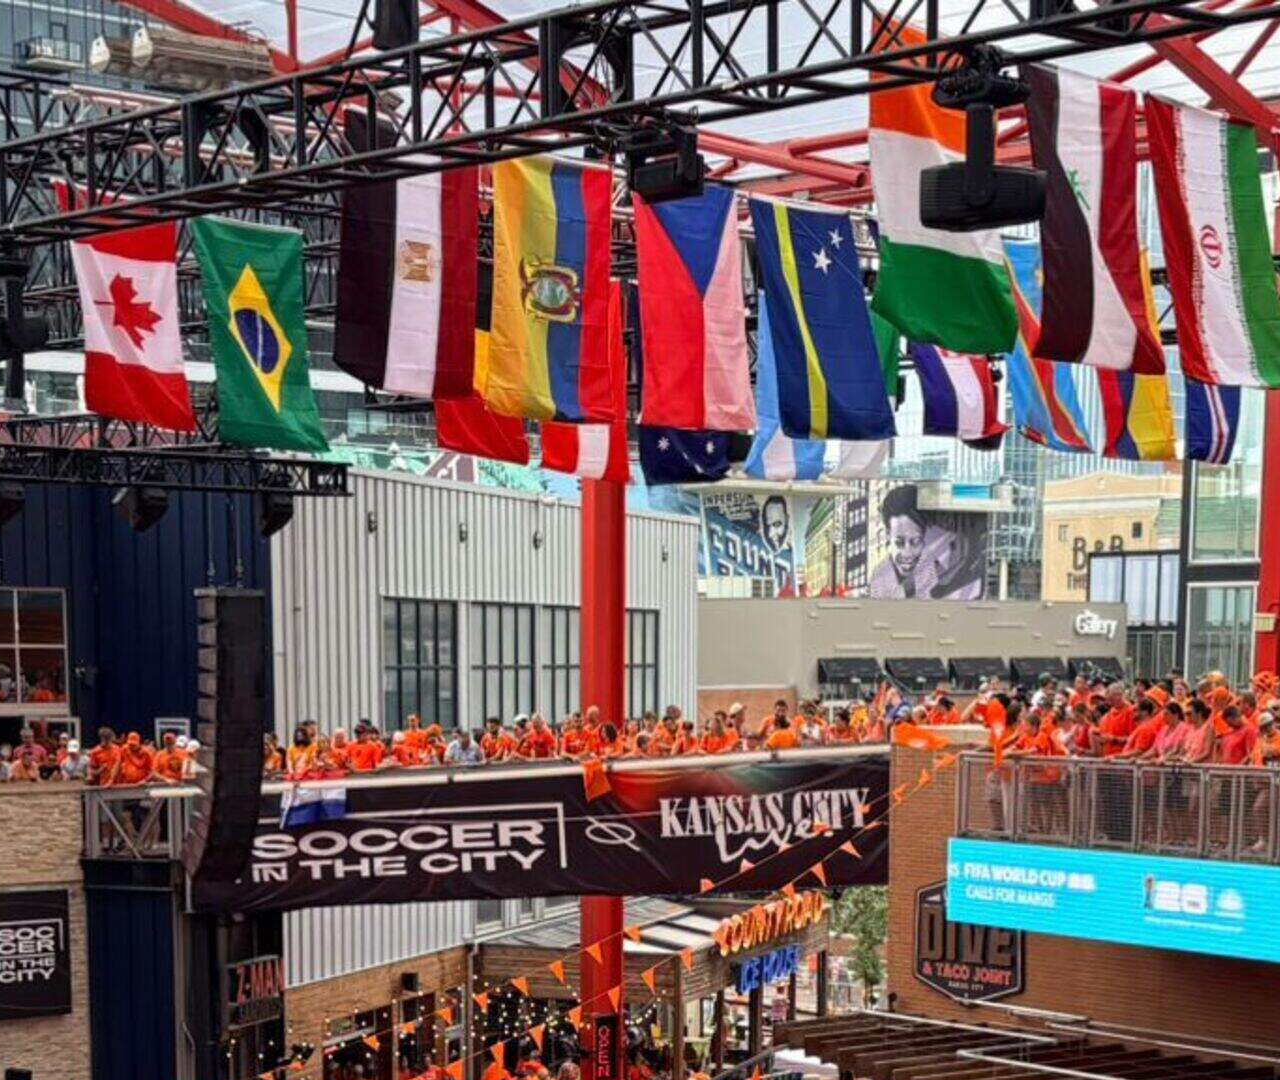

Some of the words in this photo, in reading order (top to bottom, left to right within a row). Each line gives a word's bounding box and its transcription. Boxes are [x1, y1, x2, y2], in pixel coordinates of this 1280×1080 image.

[659, 792, 785, 838] KANSAS
[252, 821, 546, 860] SOCCER
[252, 862, 288, 883] IN
[299, 855, 408, 880] THE
[420, 849, 546, 874] CITY
[991, 865, 1038, 885] WORLD
[1040, 869, 1066, 888] CUP
[919, 903, 1013, 967] DIVE
[19, 957, 56, 969] THE
[936, 962, 970, 980] TACO
[973, 967, 1013, 986] JOINT
